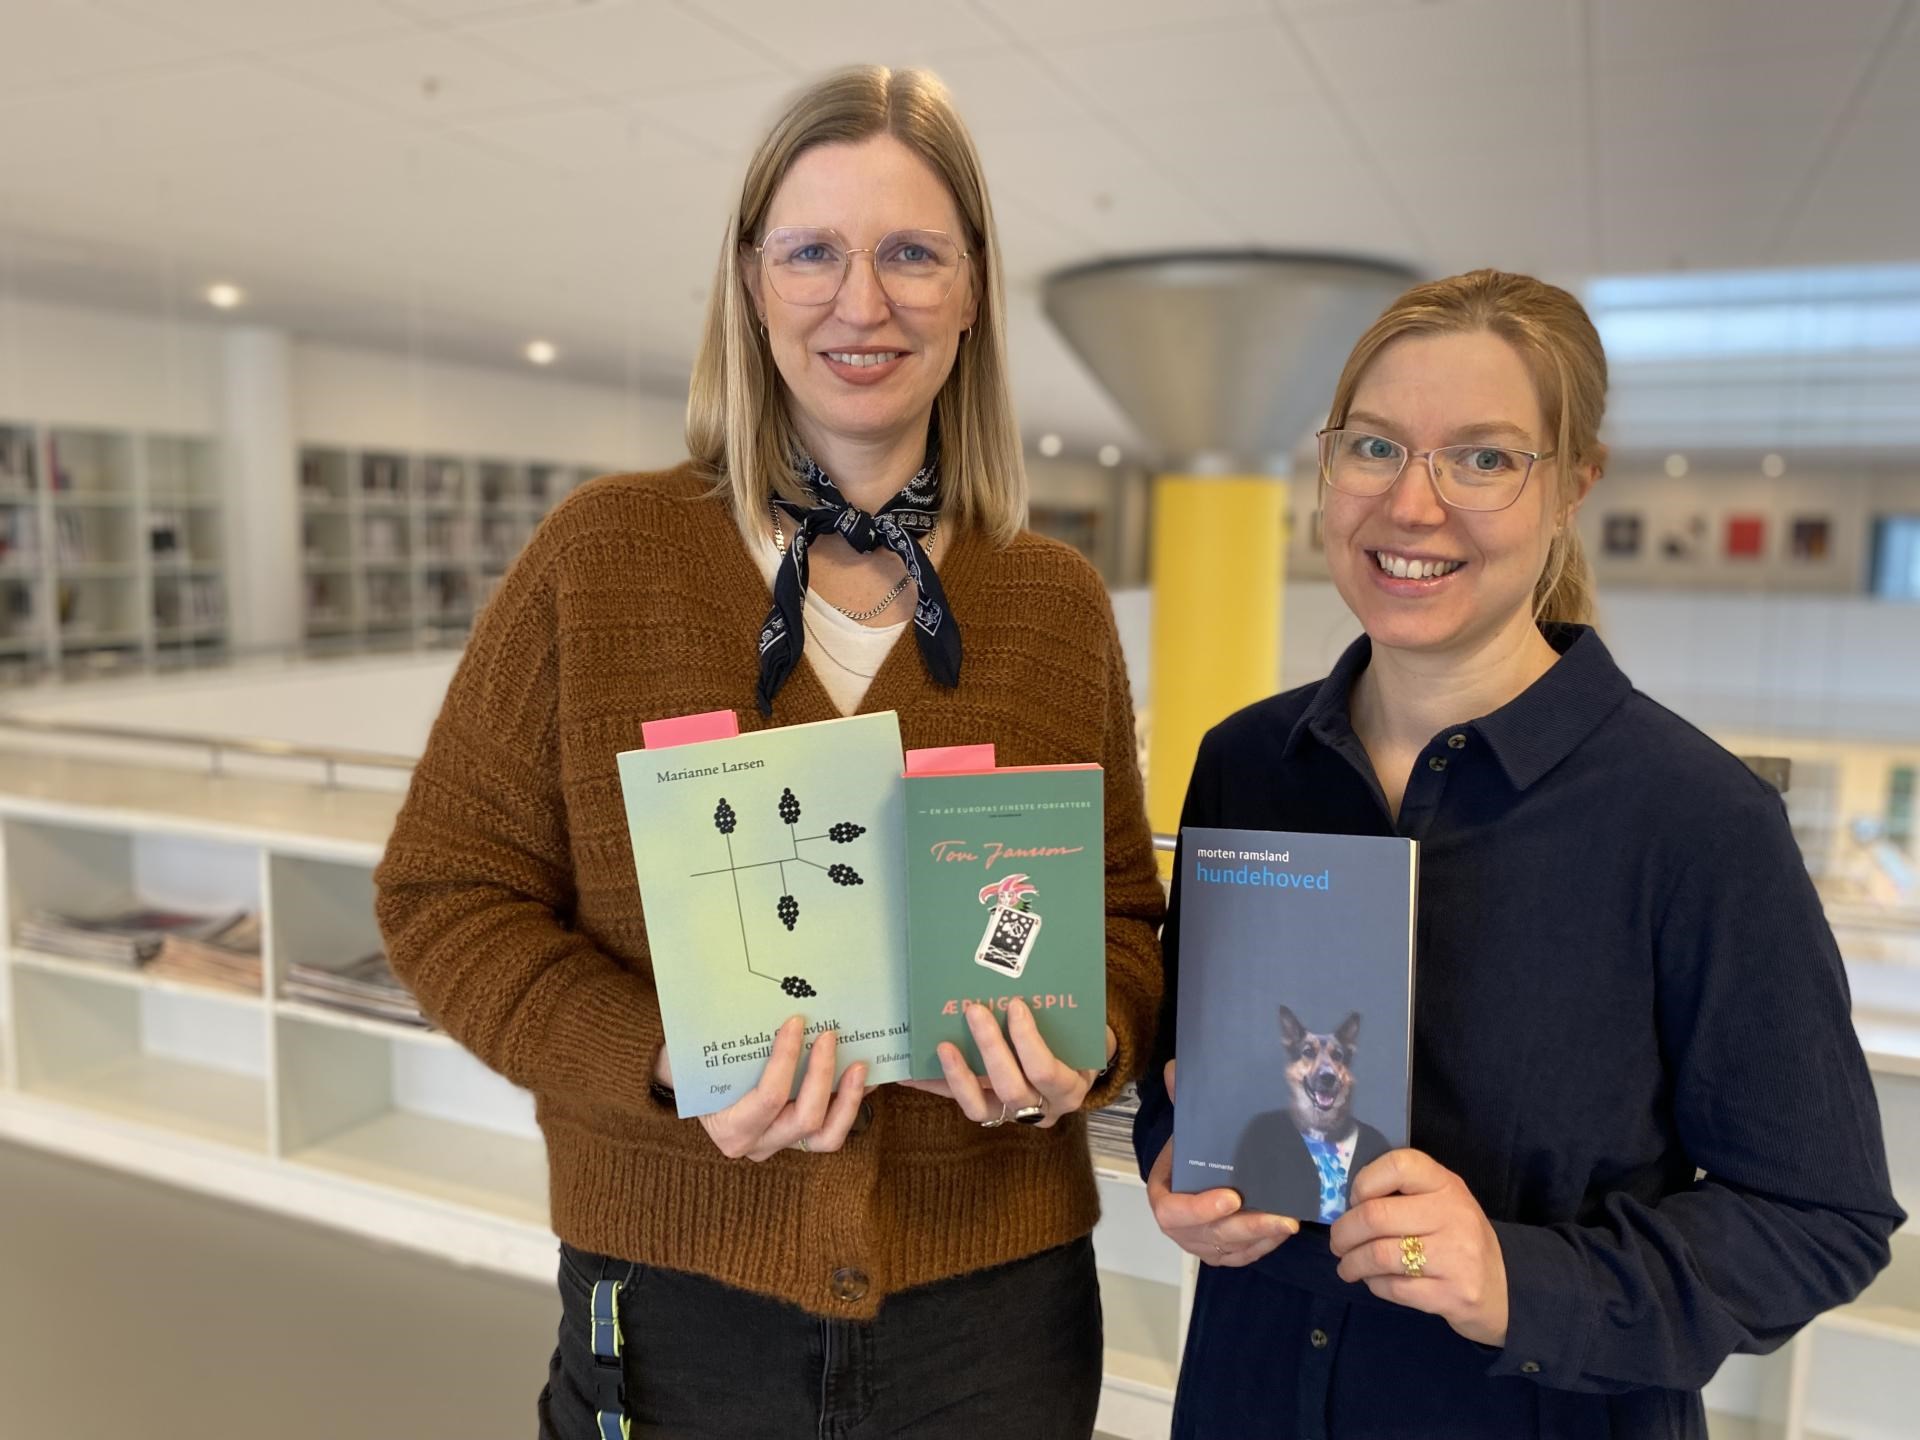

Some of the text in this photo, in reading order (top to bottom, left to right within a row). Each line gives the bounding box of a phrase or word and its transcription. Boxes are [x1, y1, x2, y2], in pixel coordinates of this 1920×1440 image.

[657, 759, 765, 783] Marianne Larsen
[957, 805, 998, 814] EUROPAS
[1000, 803, 1035, 812] FINESTE
[1037, 801, 1092, 811] FORFATTERE
[931, 840, 1084, 870] Tove Jansson
[1197, 848, 1290, 862] morten ramsland
[1197, 862, 1329, 890] hundehoved
[1032, 994, 1079, 1009] SPIL
[703, 1041, 718, 1056] på
[721, 1040, 736, 1050] en
[739, 1032, 772, 1047] skala
[803, 1019, 841, 1036] avblik
[705, 1055, 719, 1068] til
[710, 1083, 731, 1094] Digte
